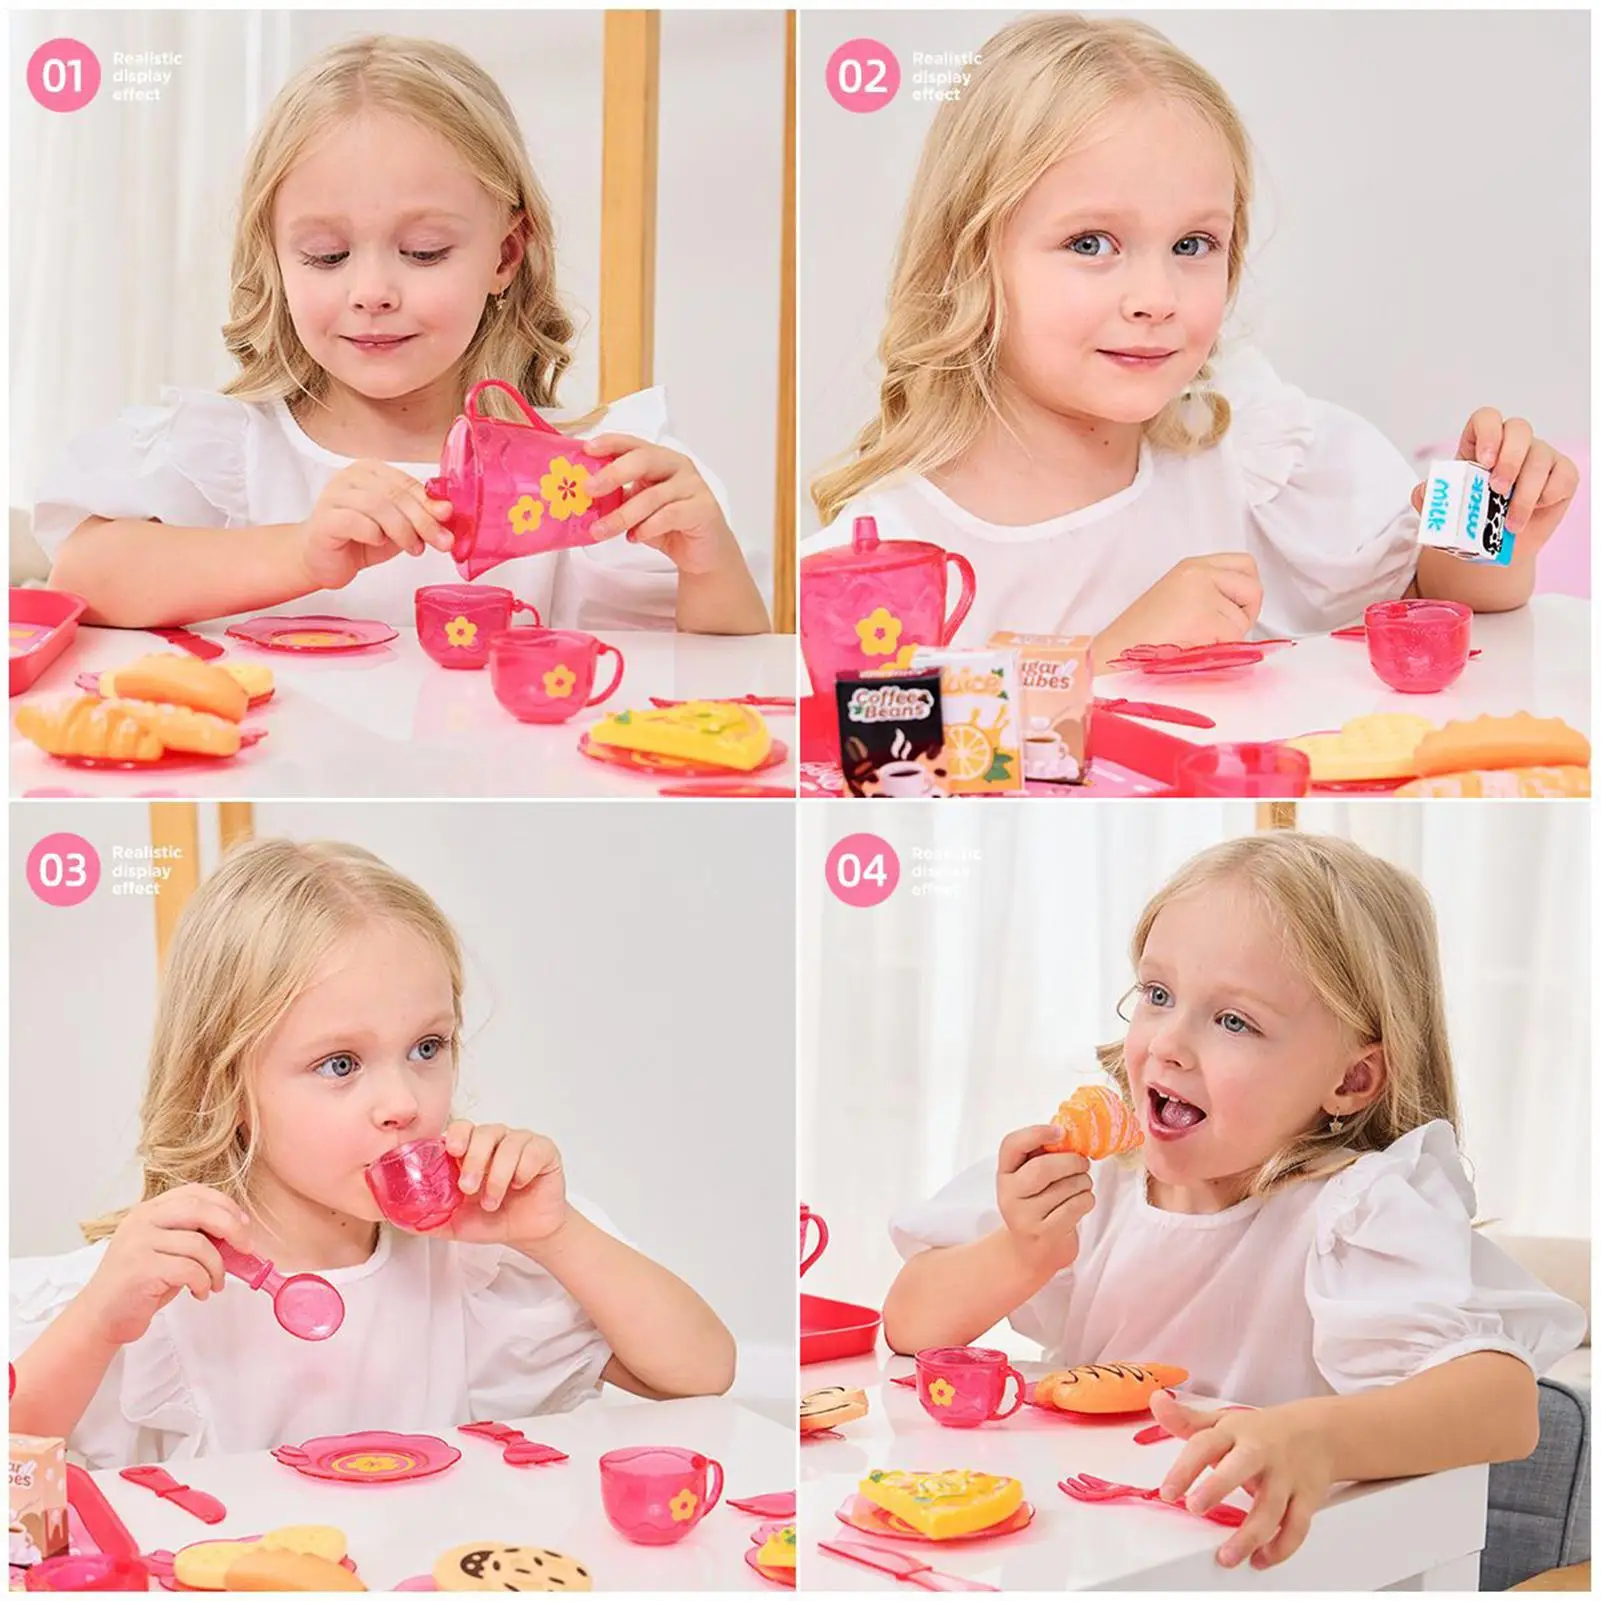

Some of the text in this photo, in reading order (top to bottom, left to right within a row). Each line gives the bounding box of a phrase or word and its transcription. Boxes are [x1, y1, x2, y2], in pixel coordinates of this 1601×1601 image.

[1021, 660, 1059, 676] gar
[1022, 674, 1070, 690] ubes
[856, 687, 919, 706] Coffee
[864, 704, 925, 718] Beans
